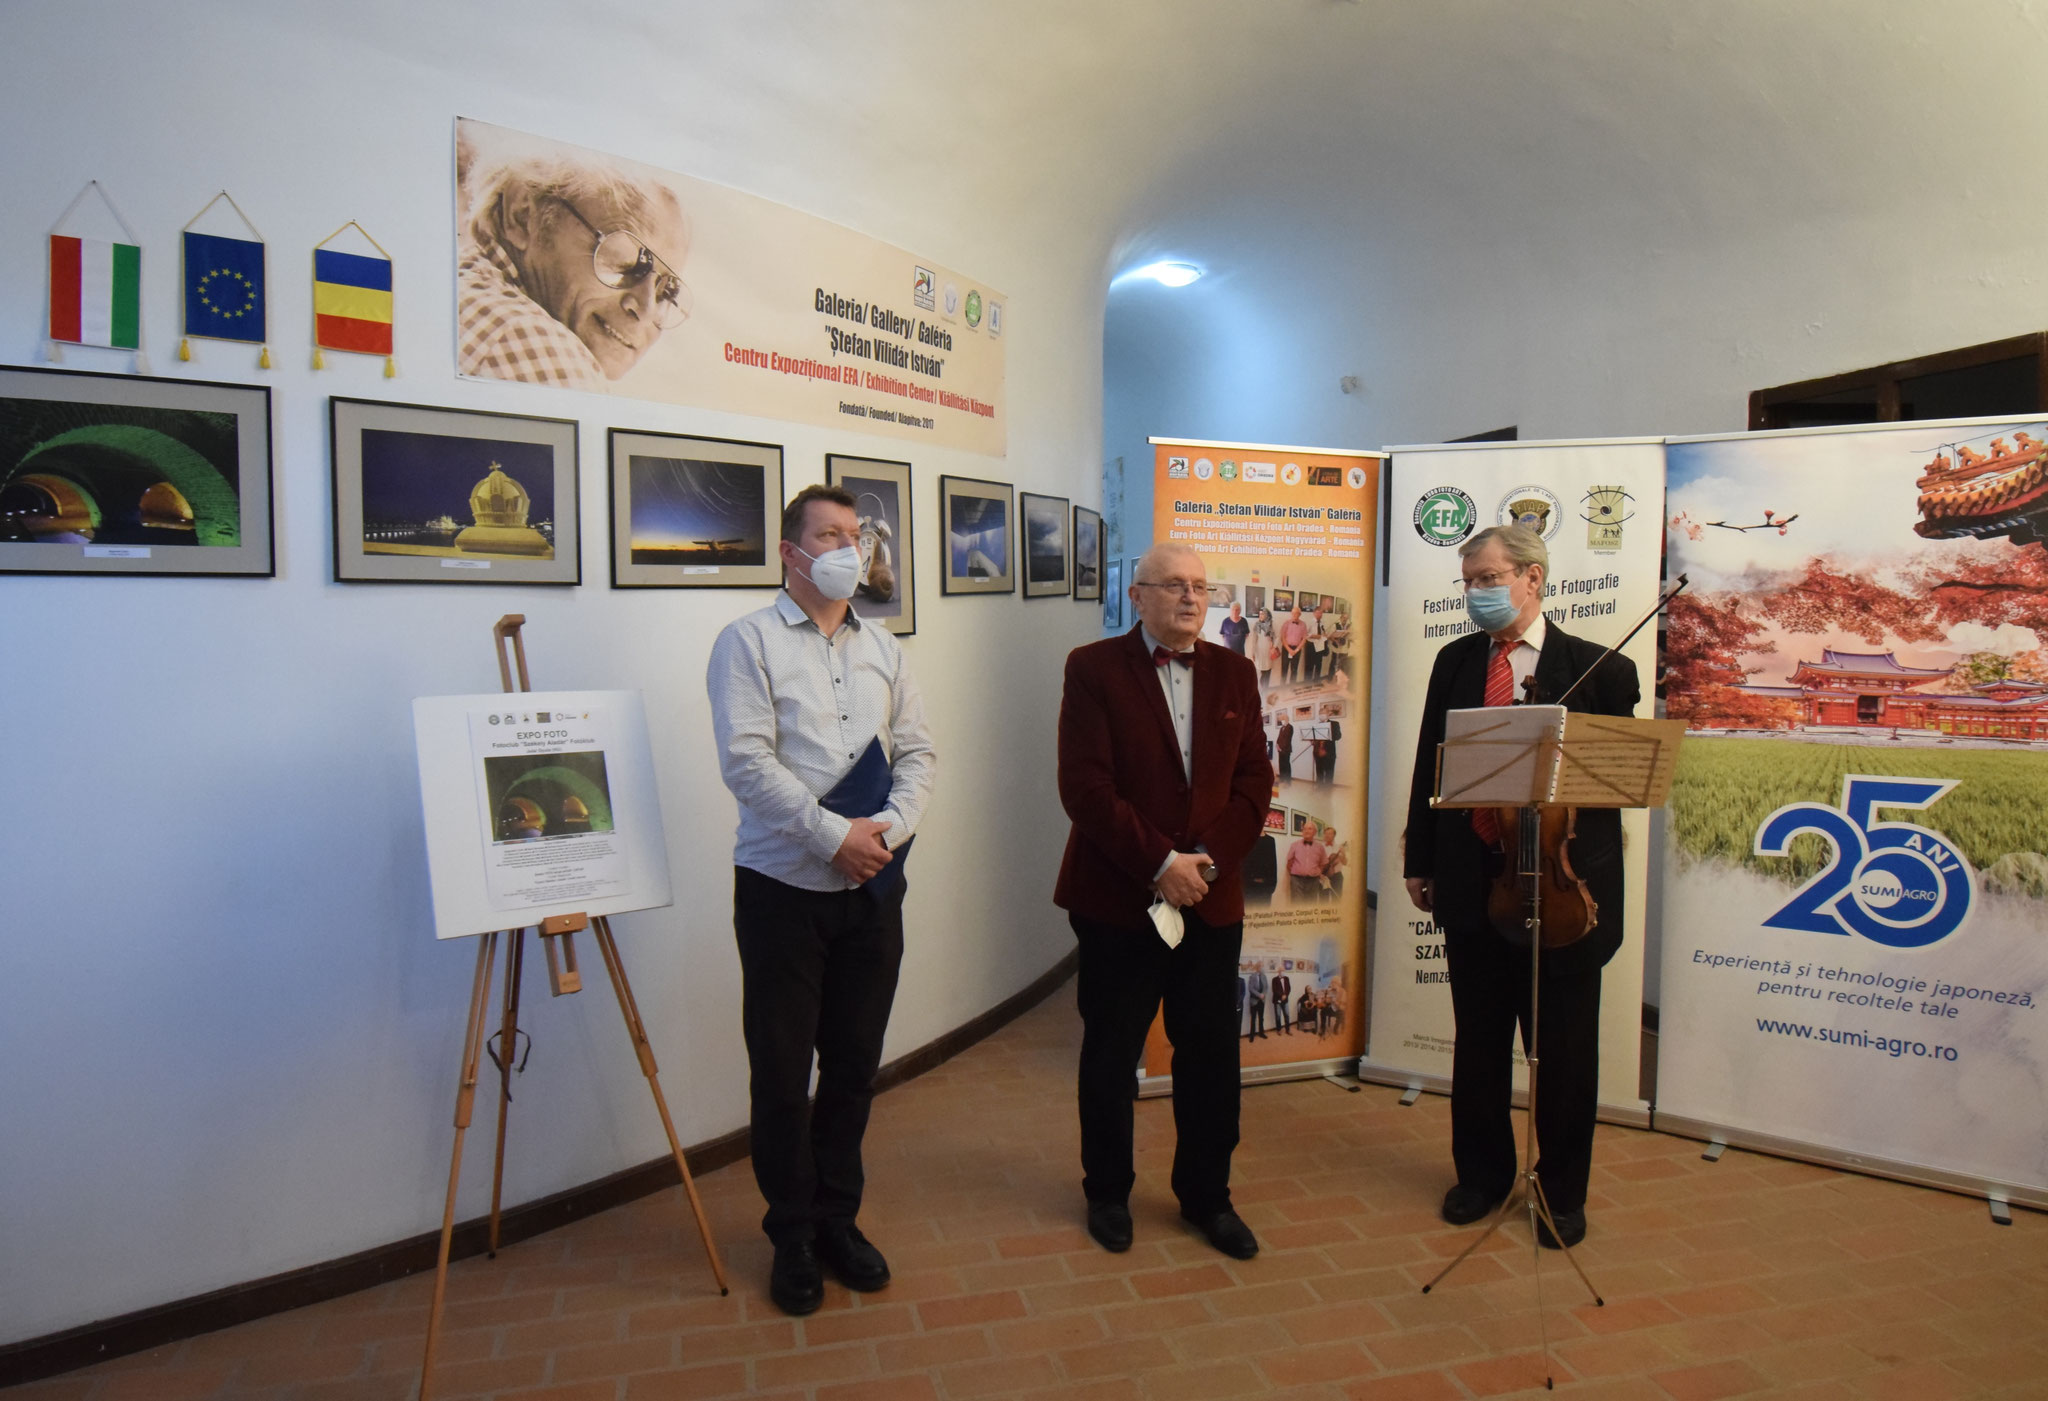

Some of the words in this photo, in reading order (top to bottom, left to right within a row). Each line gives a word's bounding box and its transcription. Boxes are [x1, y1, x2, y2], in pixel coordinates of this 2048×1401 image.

[814, 287, 868, 325] Galeria/
[871, 304, 915, 339] Gallery/
[918, 320, 952, 351] Galéria
[873, 338, 909, 369] Vilidár
[724, 342, 768, 369] Centru
[771, 351, 841, 382] Expozițional
[843, 365, 859, 387] EFA
[866, 371, 908, 398] Exhibition
[908, 382, 938, 404] Center/
[1174, 518, 1201, 528] Centru
[1249, 520, 1266, 530] Euro
[1266, 522, 1282, 531] Foto
[1284, 523, 1295, 532] Art
[1297, 523, 1325, 533] Oradea
[1175, 500, 1212, 514] Galeria
[1254, 505, 1286, 517] Vilidár
[1431, 508, 1461, 528] EFA
[1169, 530, 1187, 539] Euro
[1189, 530, 1206, 540] Foto
[1207, 531, 1218, 540] Art
[1194, 543, 1216, 552] Photo
[1217, 544, 1228, 553] Art
[1230, 545, 1267, 555] Exhibition
[1268, 546, 1293, 556] Center
[1295, 547, 1323, 557] Oradea
[1423, 594, 1465, 614] Festival
[1544, 582, 1556, 598] de
[1561, 573, 1619, 595] Fotografie
[1541, 606, 1567, 624] phy
[1571, 599, 1616, 620] Festival
[516, 731, 541, 740] EXPO
[544, 730, 568, 738] FOTO
[1756, 776, 1975, 950] 25
[1904, 833, 1960, 874] ANI
[1692, 949, 1791, 977] Experiență
[1797, 962, 1811, 980] și
[1818, 964, 1927, 995] tehnologie
[1930, 979, 2037, 1010] japoneză,
[1757, 979, 1822, 1000] pentru
[1828, 986, 1913, 1014] recoltele
[1920, 1000, 1960, 1020] tale
[1756, 1017, 1959, 1063] www.sumi-agro.ro
